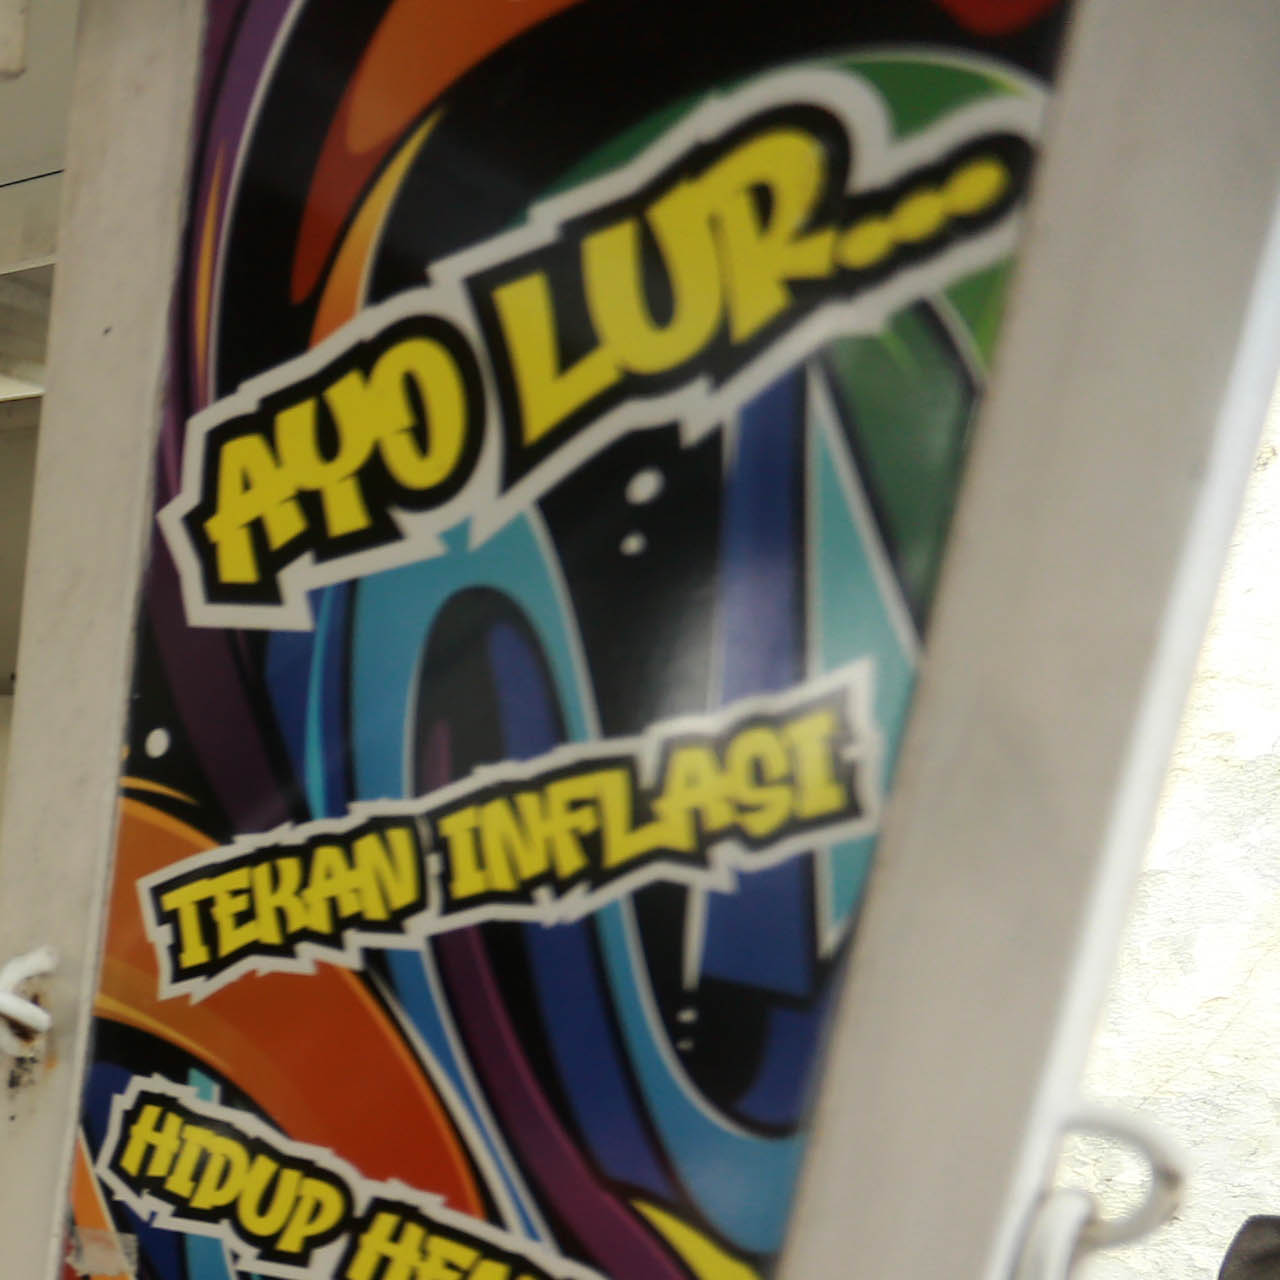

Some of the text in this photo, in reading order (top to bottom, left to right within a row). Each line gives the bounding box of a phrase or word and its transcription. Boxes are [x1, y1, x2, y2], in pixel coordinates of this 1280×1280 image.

[203, 335, 467, 584] AYO
[159, 708, 846, 970] TEKAN INFLASI
[120, 1104, 348, 1256] HIDUP
